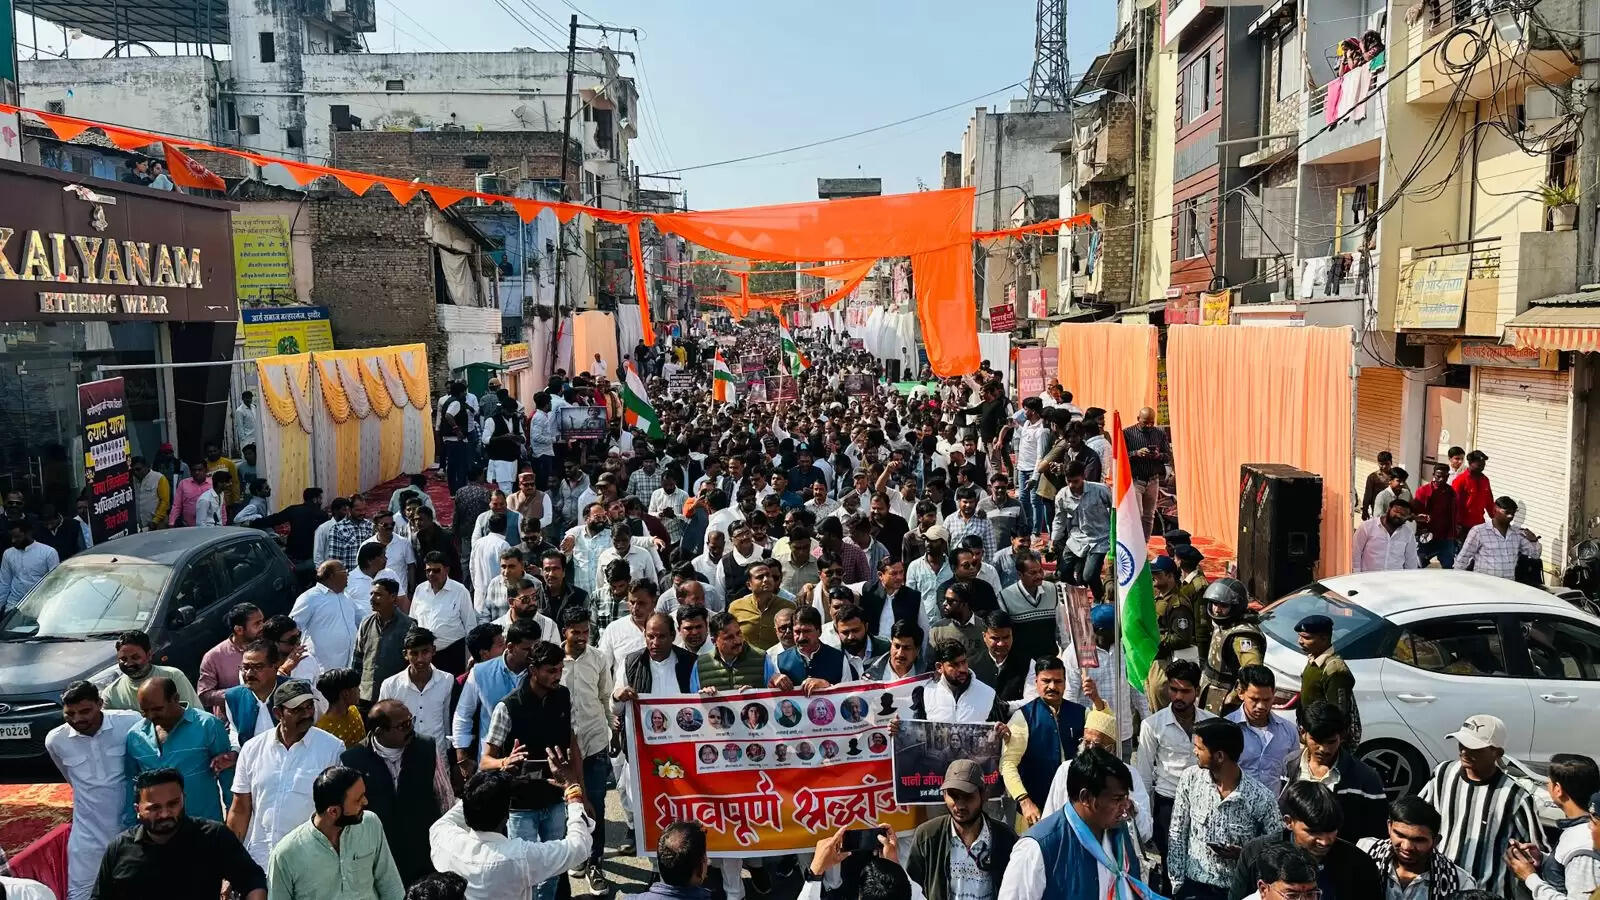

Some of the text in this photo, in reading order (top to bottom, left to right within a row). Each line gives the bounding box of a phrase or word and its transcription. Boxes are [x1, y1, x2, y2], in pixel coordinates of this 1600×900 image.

[39, 291, 169, 314] ETHENIC WEAR
[252, 312, 263, 322] आर्य
[264, 313, 280, 321] समाज
[86, 415, 126, 443] न्याय यात्रा
[94, 486, 133, 514] अधिकारियों को
[902, 772, 921, 787] पानी
[654, 771, 909, 847] भावपूर्ण श्रद्धांज
